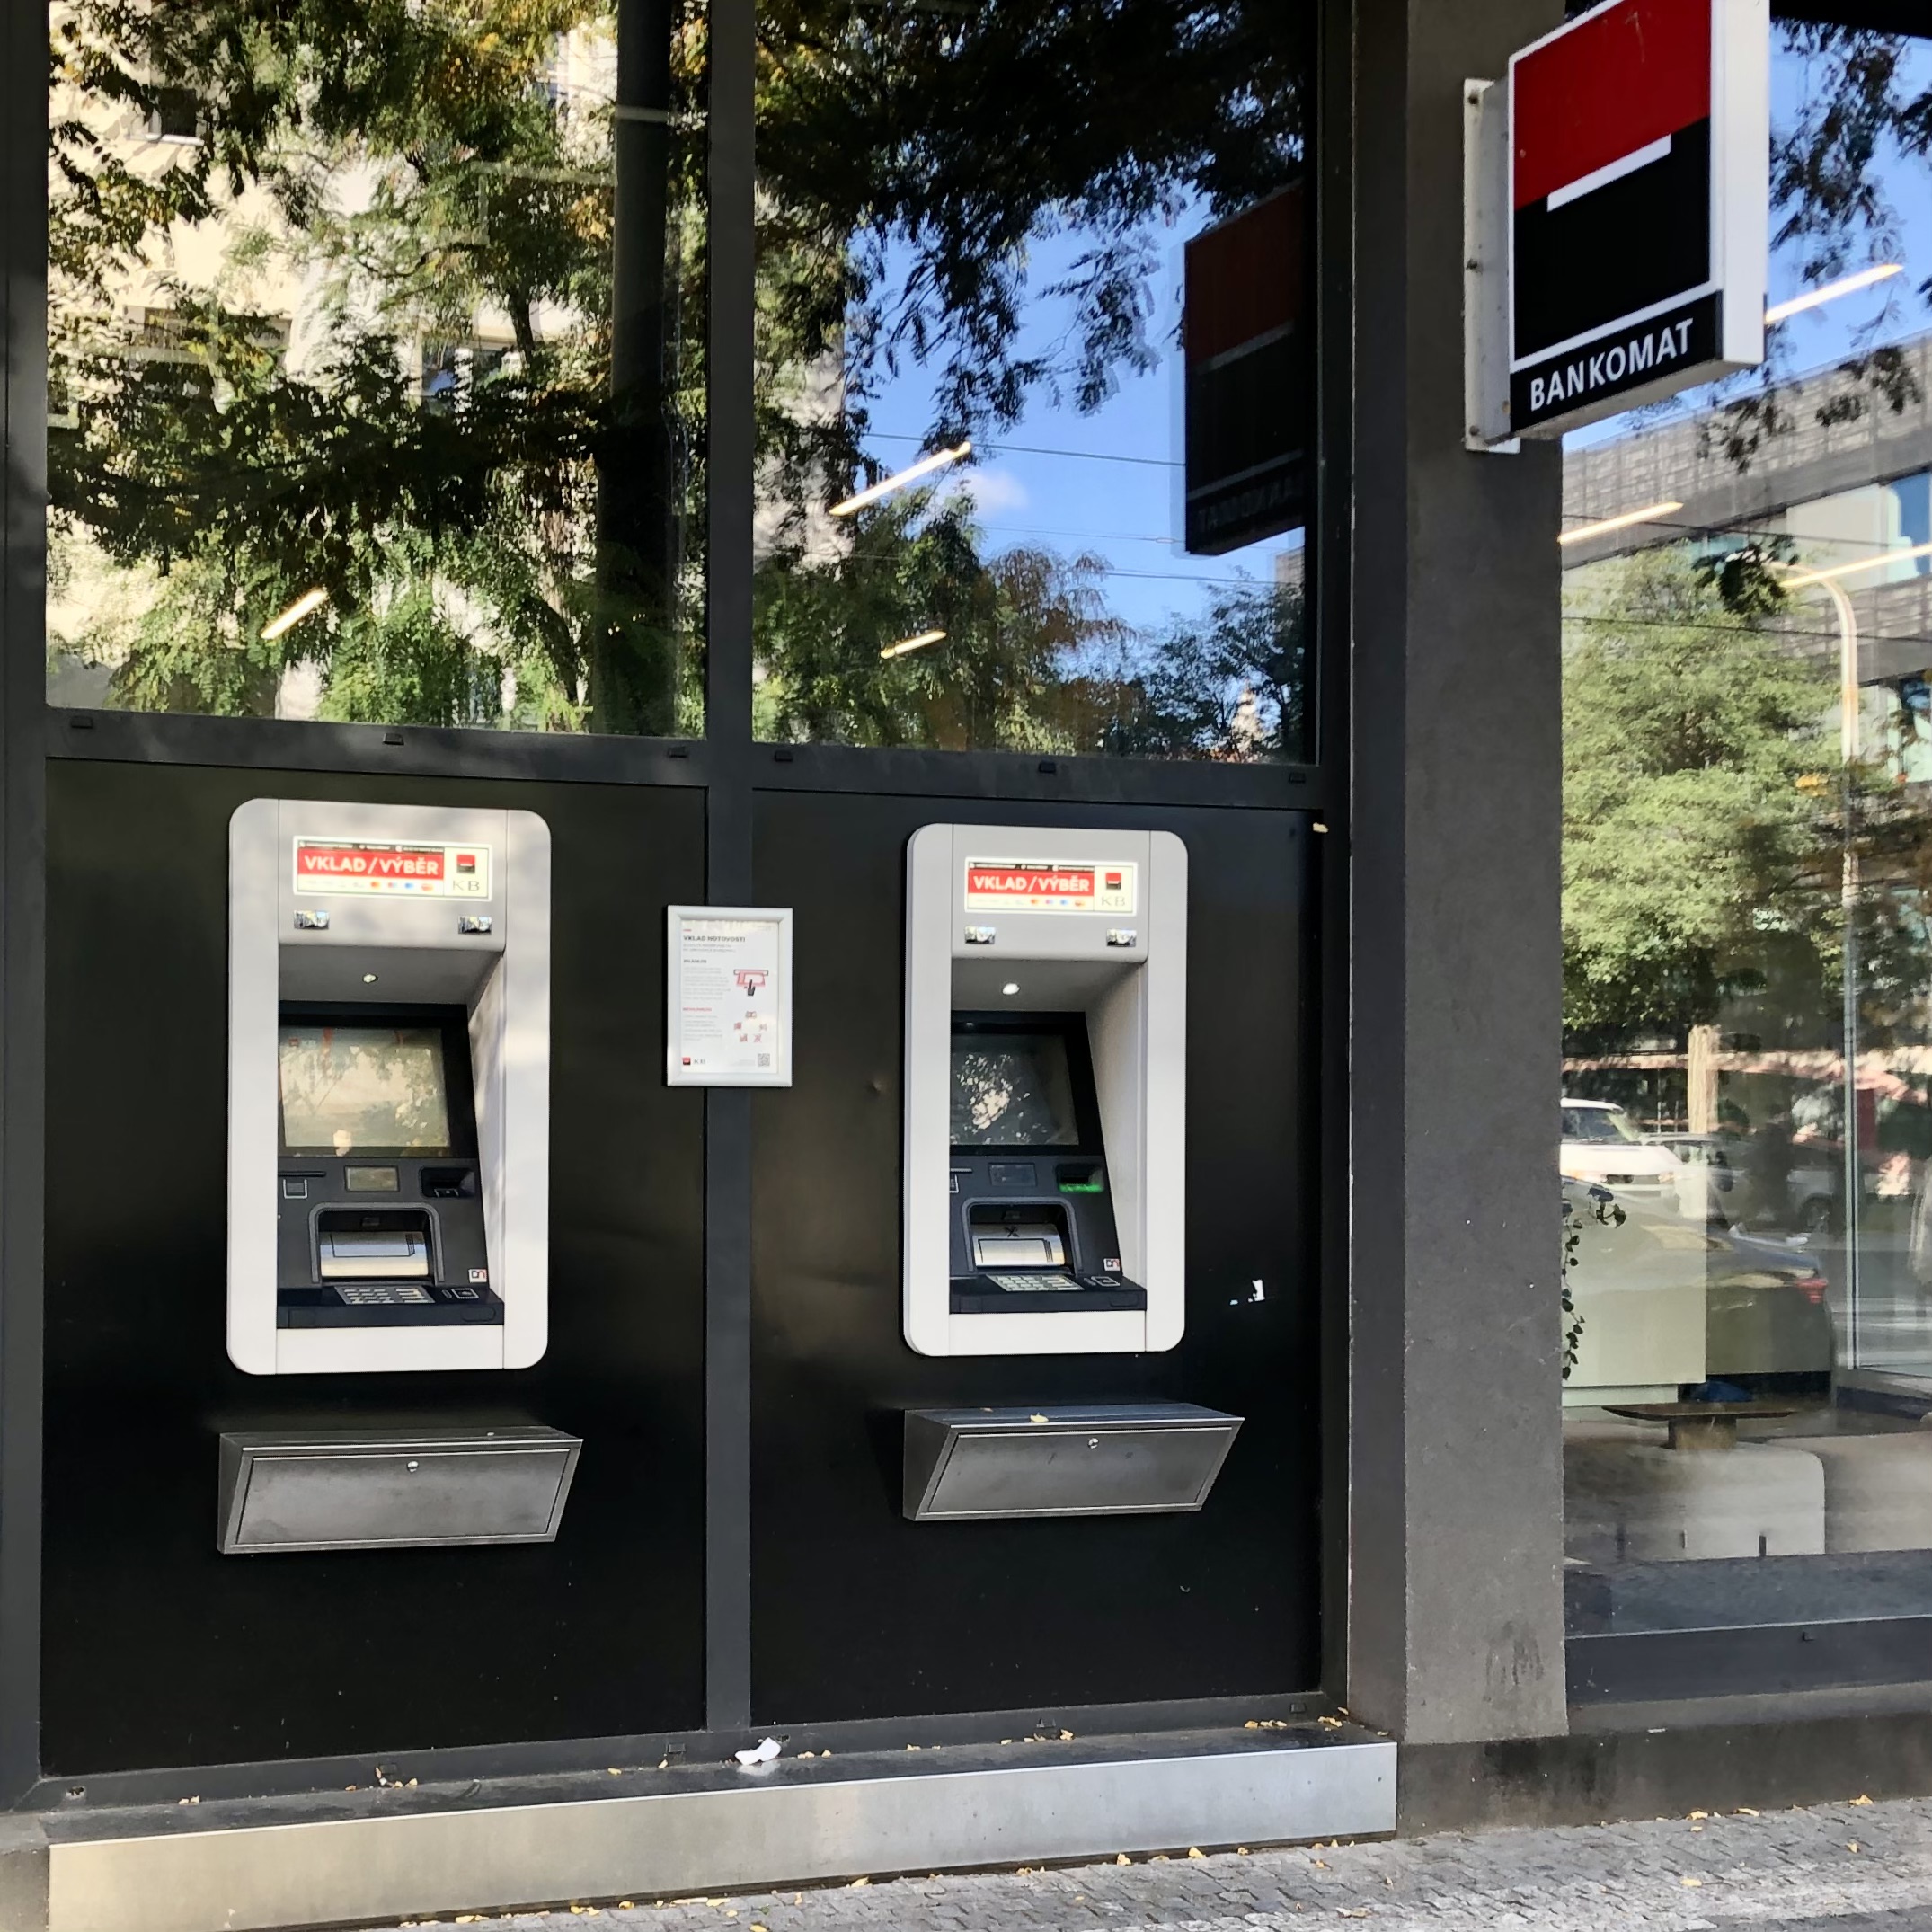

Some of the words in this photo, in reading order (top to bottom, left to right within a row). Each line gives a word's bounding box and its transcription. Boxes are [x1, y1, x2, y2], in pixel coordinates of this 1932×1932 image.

[1530, 317, 1694, 412] BANKOMAT
[304, 855, 439, 875] VKLAD/VÝBĚR
[452, 880, 480, 891] KB
[973, 875, 1090, 893] VKLAD/VÝBĚR
